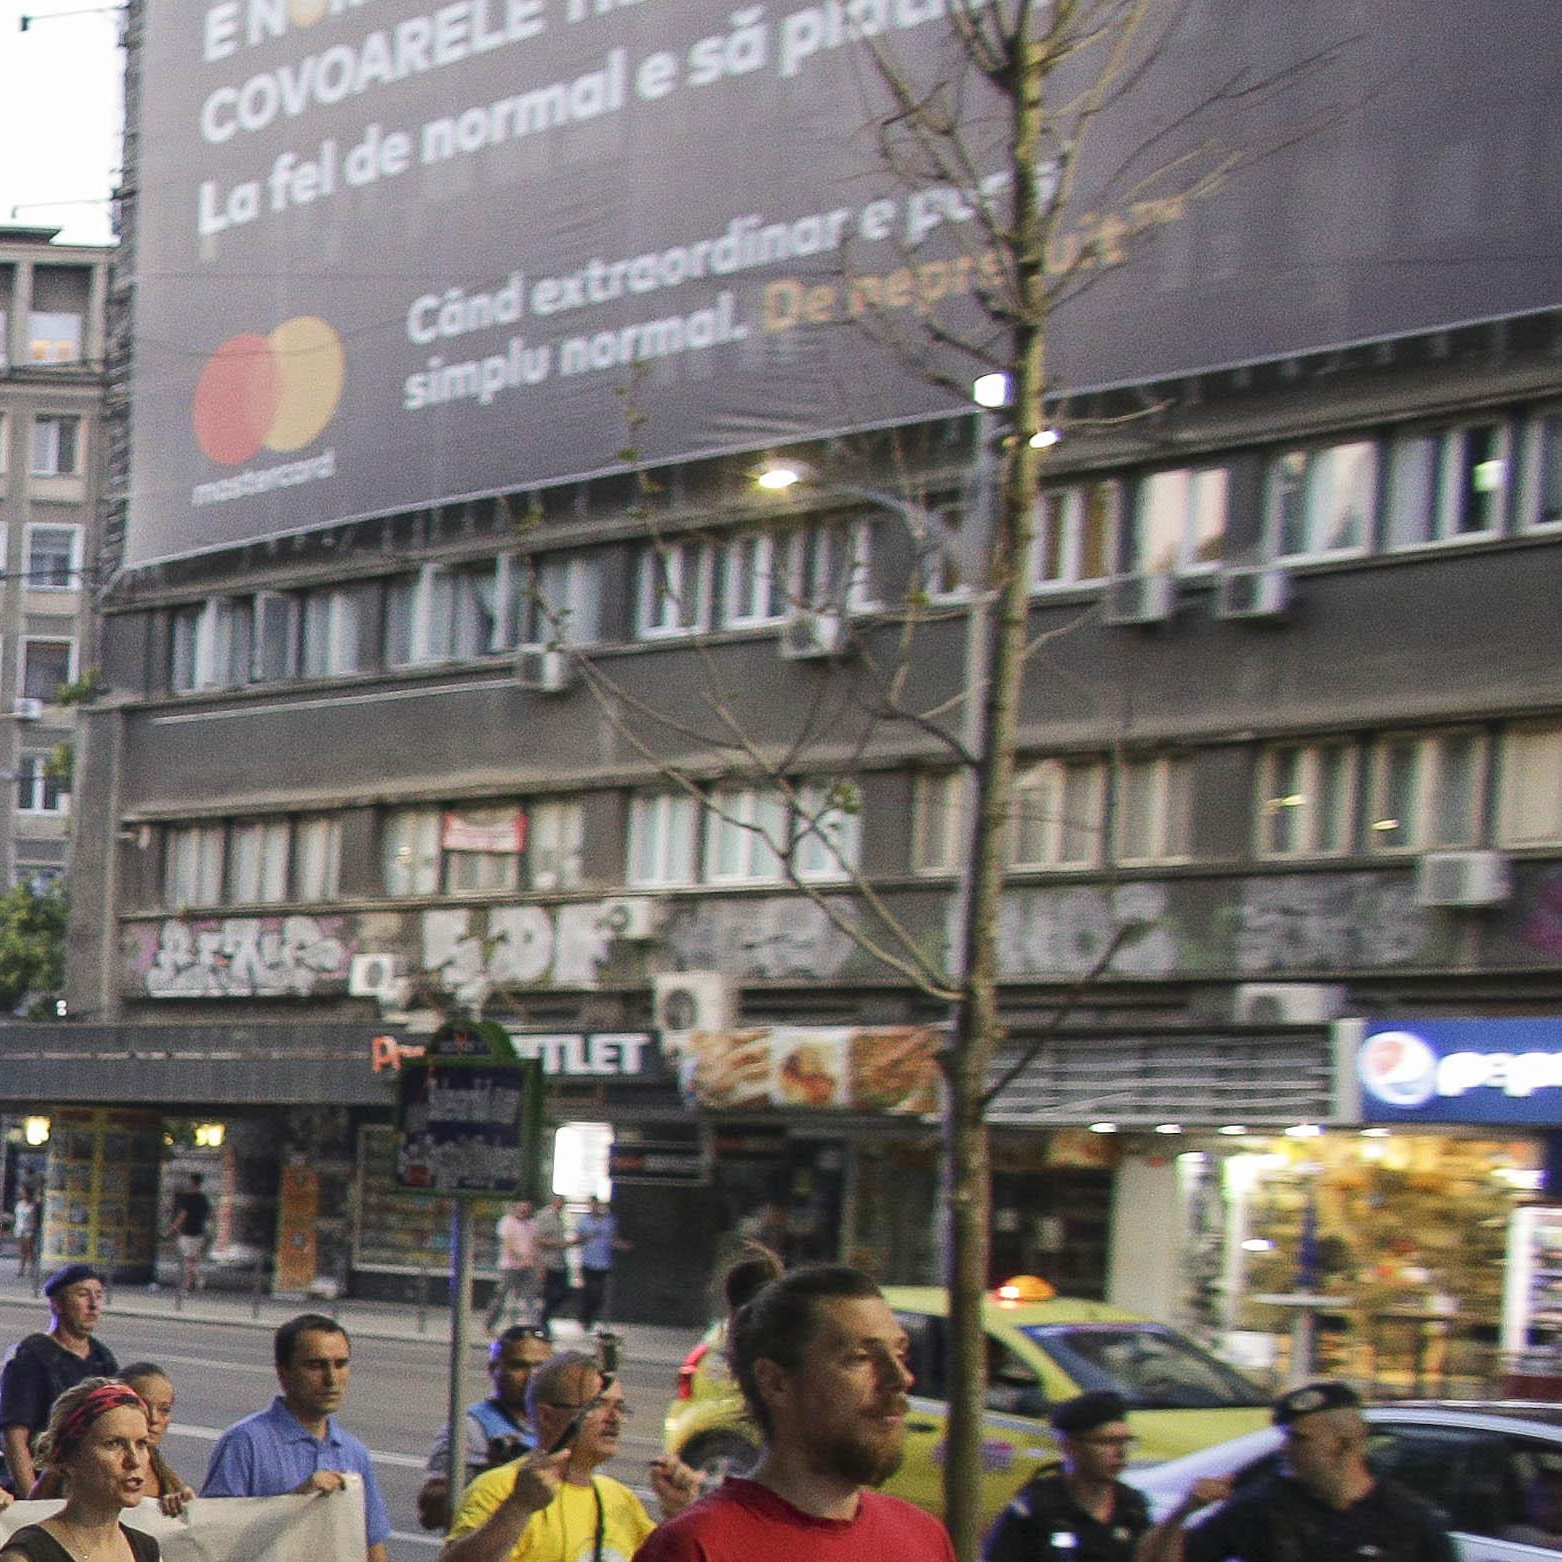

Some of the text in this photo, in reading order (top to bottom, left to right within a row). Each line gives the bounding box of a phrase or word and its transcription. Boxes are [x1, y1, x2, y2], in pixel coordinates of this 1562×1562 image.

[200, 0, 547, 144] COVOARELE
[202, 2, 240, 63] E
[198, 180, 261, 237] La
[269, 137, 338, 213] fel
[344, 122, 414, 187] de
[420, 46, 627, 165] normal
[637, 49, 677, 99] e
[688, 5, 769, 88] să
[405, 271, 526, 344] Când
[531, 207, 851, 317] extraordinar
[860, 198, 898, 241] e
[403, 336, 552, 411] simplu
[560, 290, 749, 377] normal.
[765, 278, 838, 334] De
